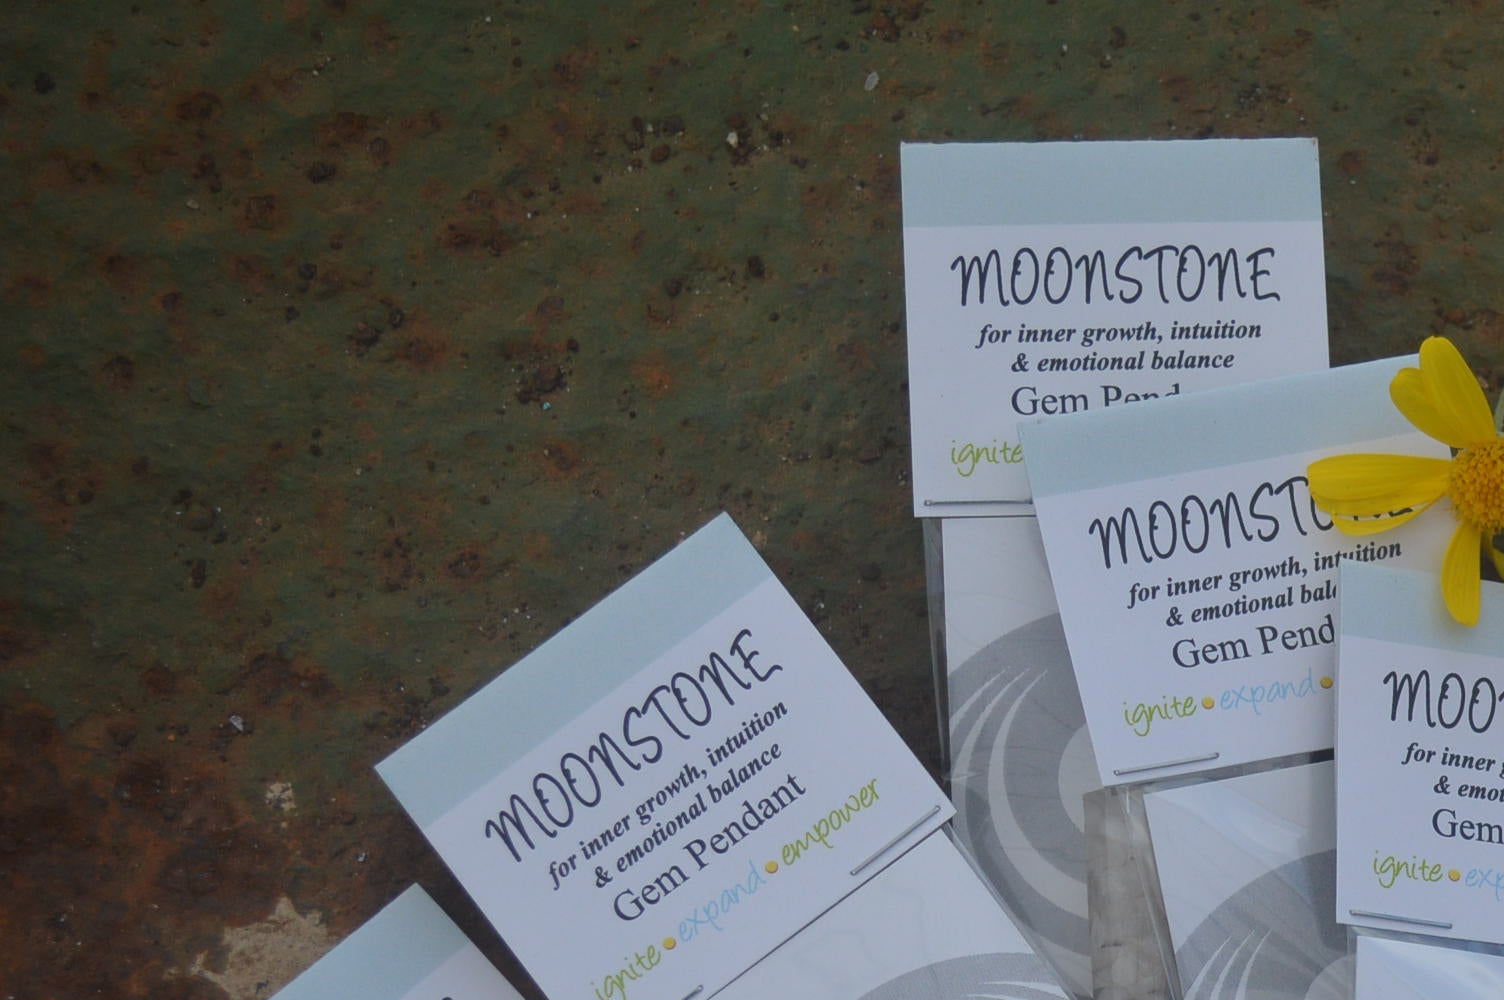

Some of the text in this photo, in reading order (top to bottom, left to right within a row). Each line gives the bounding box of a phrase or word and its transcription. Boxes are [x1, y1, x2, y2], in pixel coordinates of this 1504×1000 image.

[950, 244, 1280, 306] MOONSTONE
[975, 321, 1262, 348] for inner growth, intuition
[1011, 352, 1234, 372] & emotional balance
[1011, 385, 1088, 415] Gem
[951, 439, 1024, 476] ignite
[1089, 475, 1413, 568] MOONST
[1127, 583, 1160, 609] for
[1167, 573, 1223, 597] inner
[1228, 558, 1308, 591] growth,
[1165, 607, 1184, 627] &
[1191, 584, 1294, 623] emotional
[1172, 638, 1249, 668] Gem
[1123, 667, 1317, 736] ignite expand
[485, 628, 783, 862] MOONSTONE
[1401, 742, 1436, 766] for
[1441, 747, 1496, 772] inner
[548, 701, 788, 891] for inner growth, intuition
[1433, 775, 1451, 795] &
[594, 742, 782, 888] & emotional balance
[1432, 808, 1504, 846] Gem
[613, 773, 806, 921] Gem Pendant
[678, 859, 767, 943] expand
[781, 777, 880, 865] empower
[1373, 850, 1443, 888] ignite
